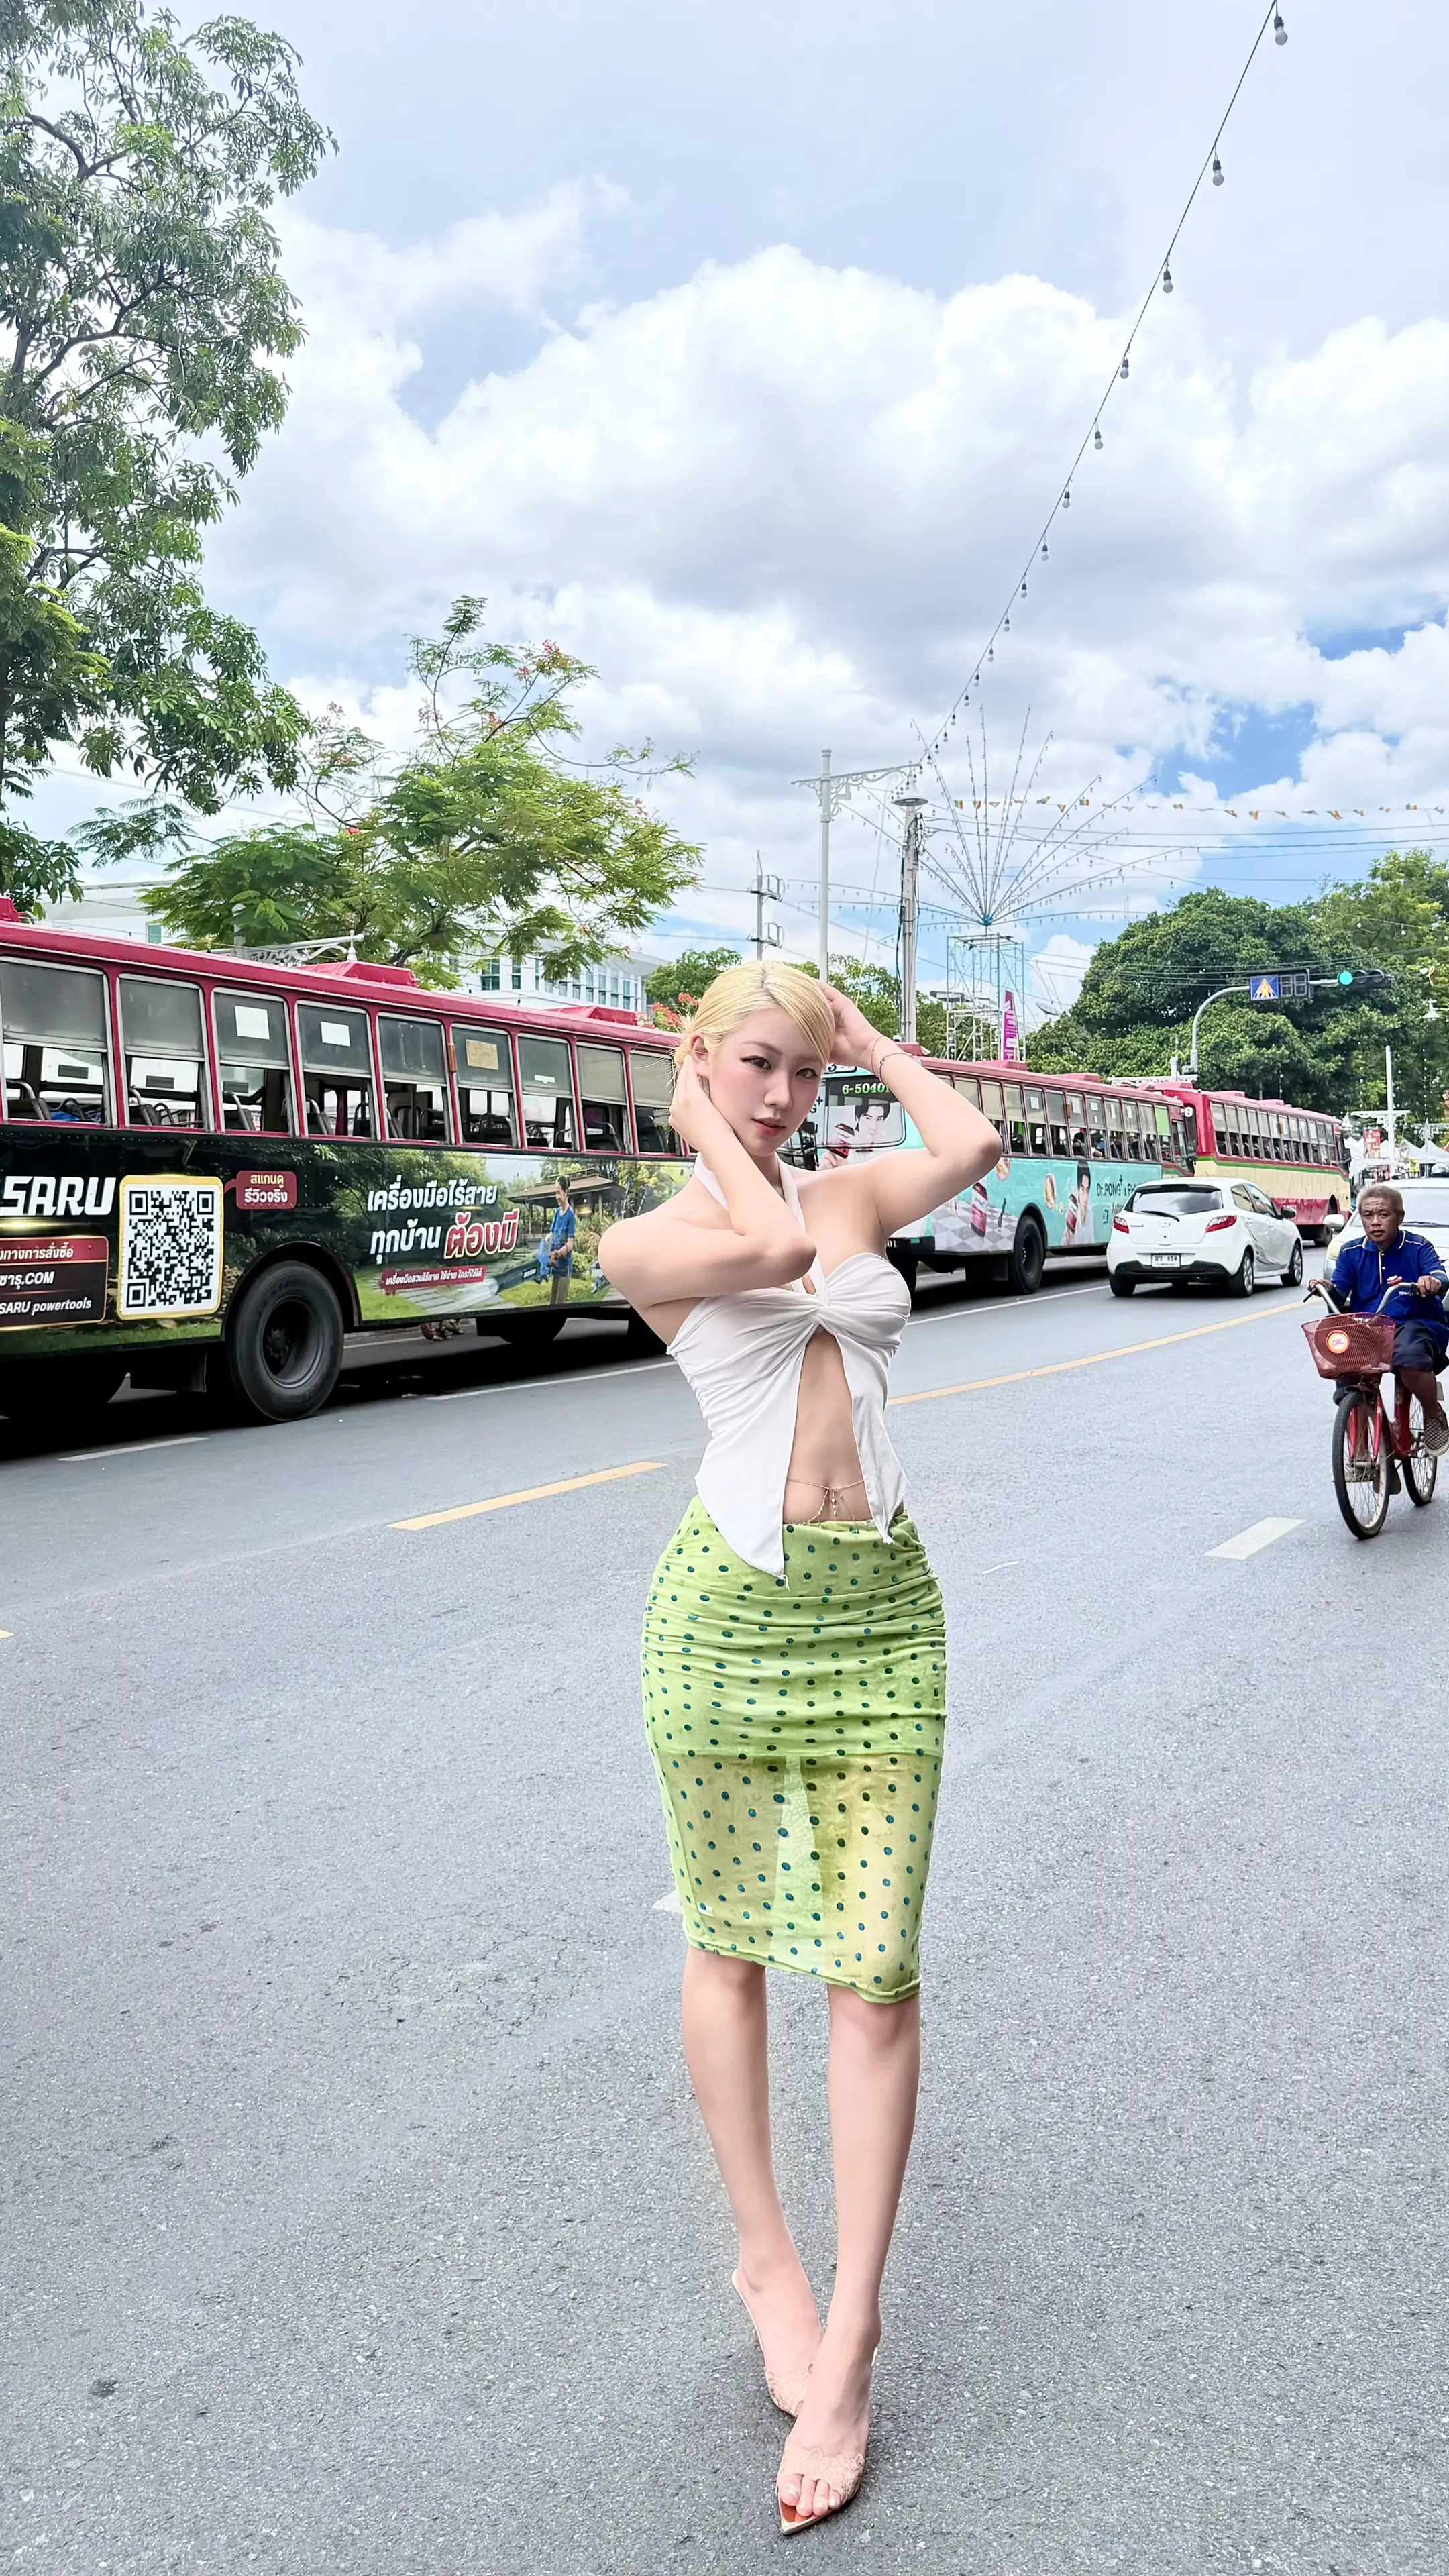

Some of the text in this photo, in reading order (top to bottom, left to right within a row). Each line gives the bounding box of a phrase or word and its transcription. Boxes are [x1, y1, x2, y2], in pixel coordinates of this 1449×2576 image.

[0, 1175, 117, 1216] SARU
[244, 1187, 288, 1203] รีวิวจริง
[250, 1174, 284, 1189] สแกนดู
[367, 1174, 498, 1212] เครื่องมือไร้สาย
[370, 1208, 520, 1265] ทุกบ้าน ต้องมี
[0, 1296, 92, 1316] SARU powertools
